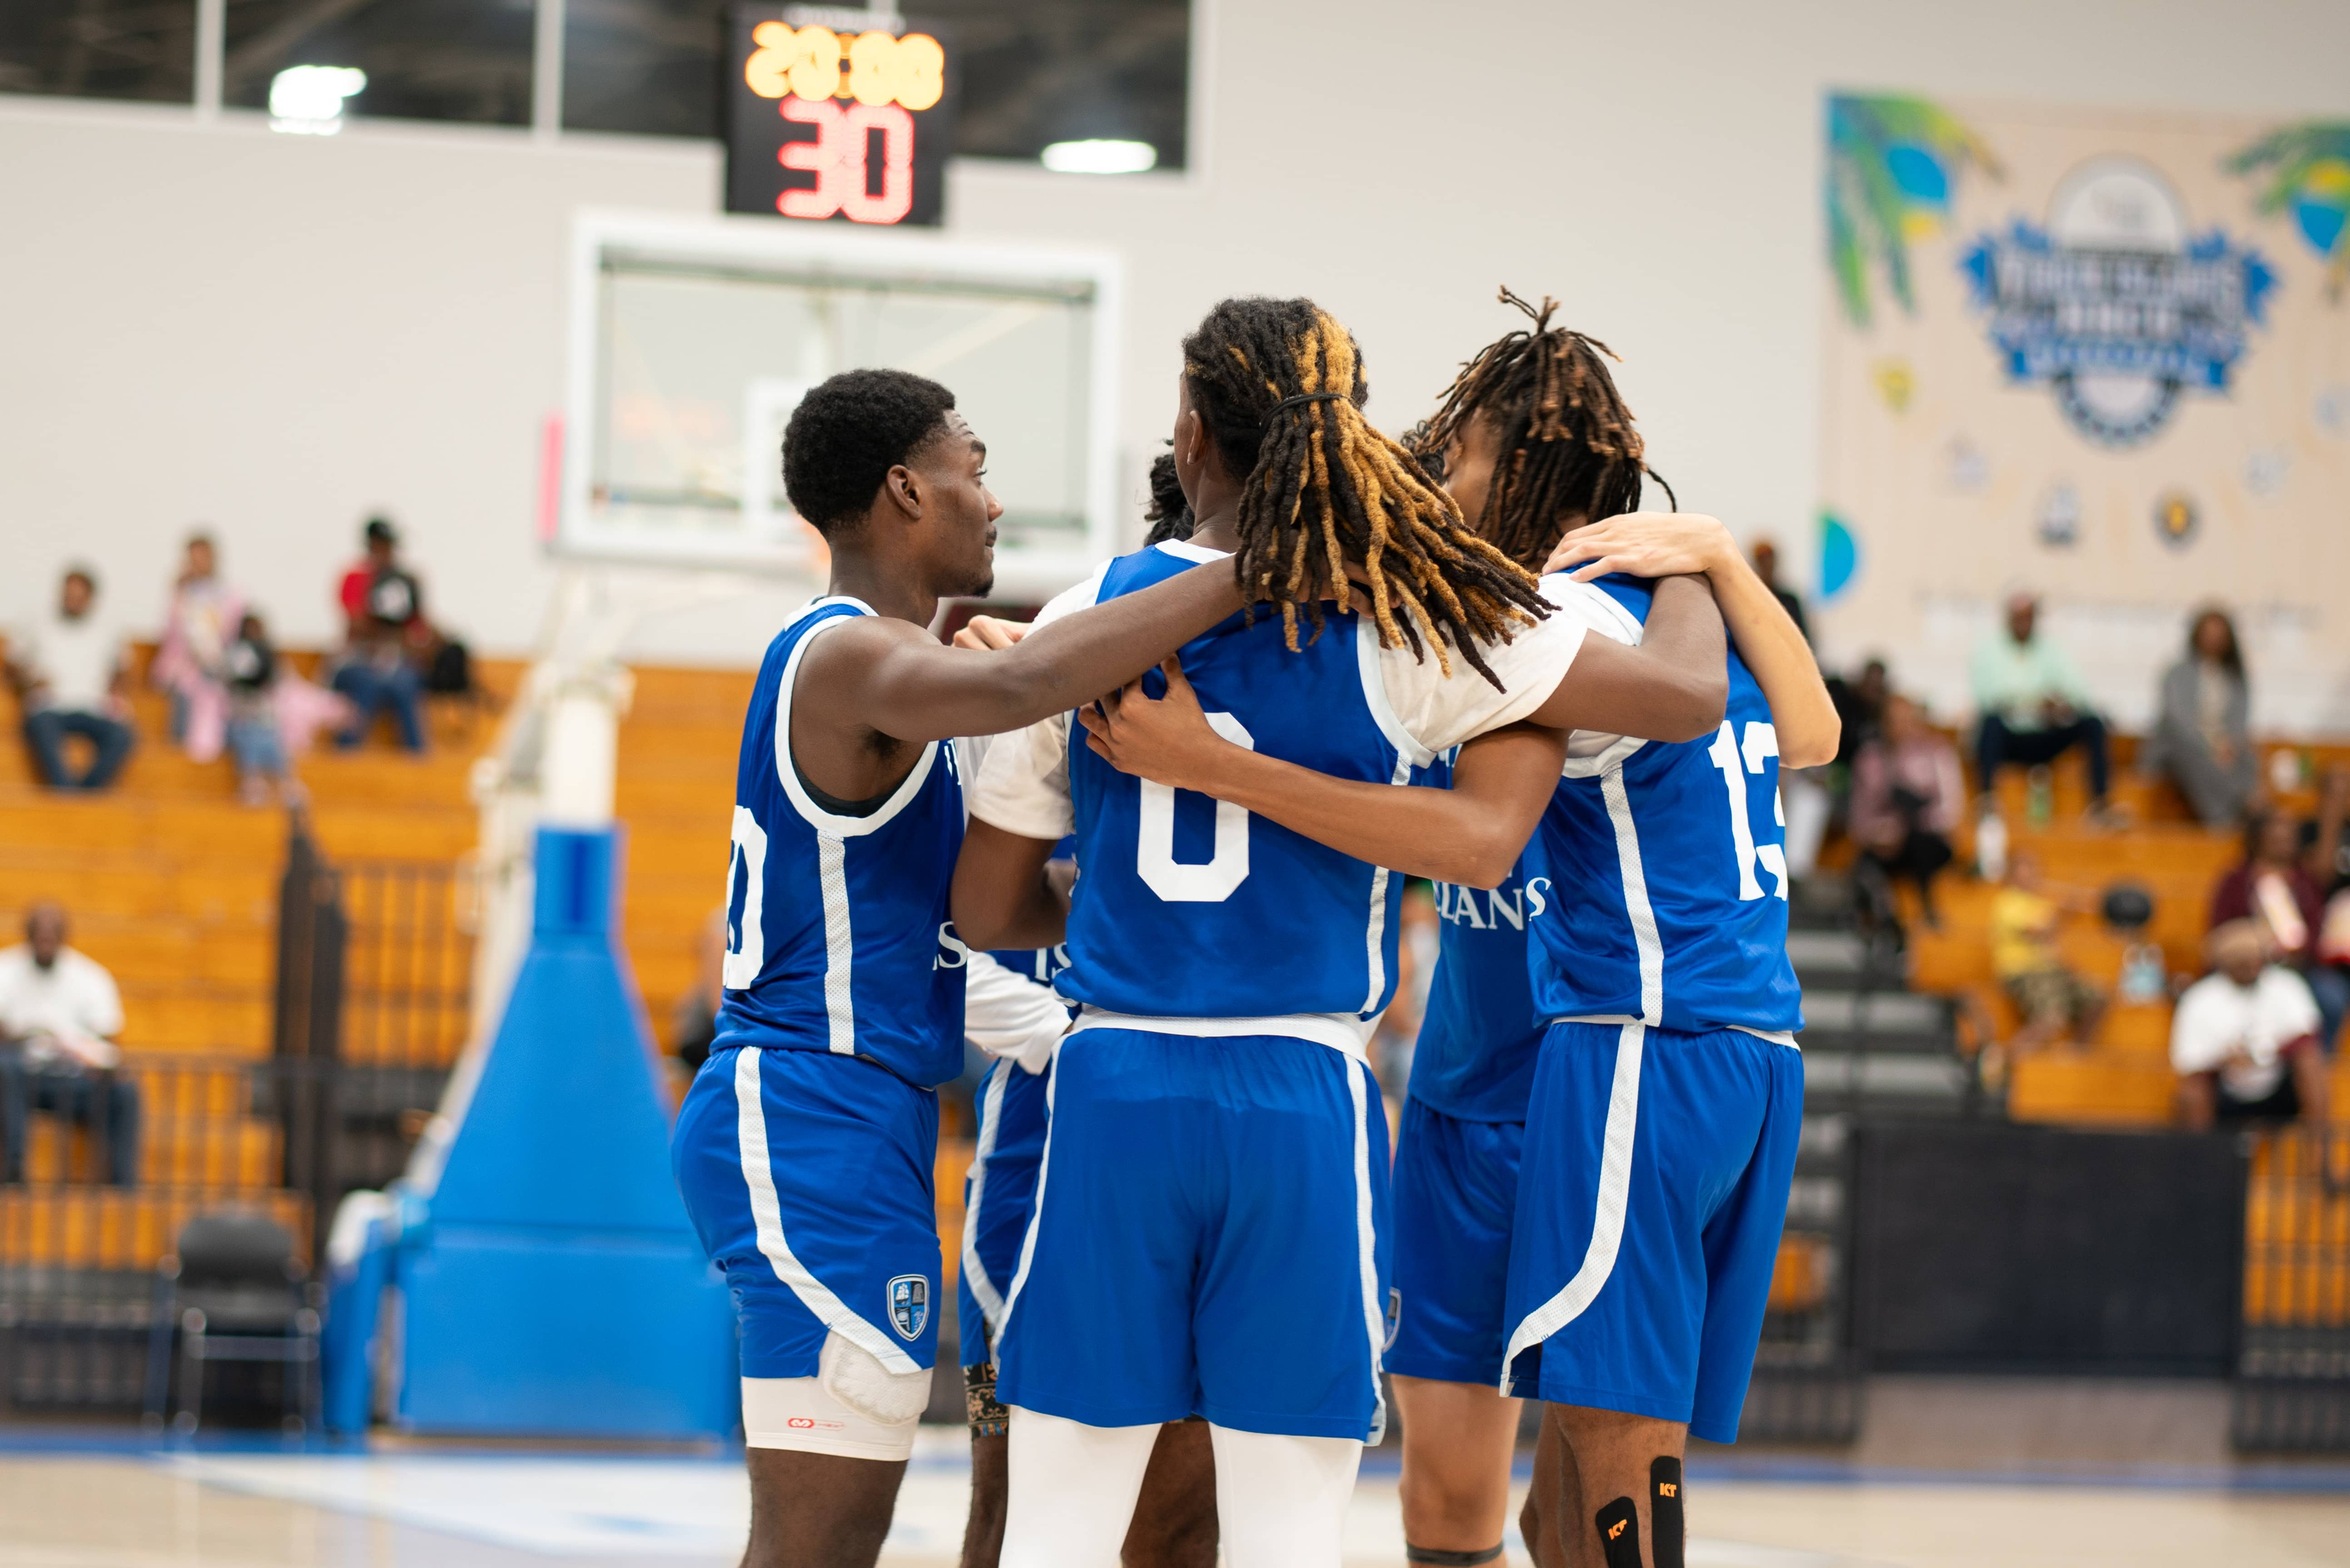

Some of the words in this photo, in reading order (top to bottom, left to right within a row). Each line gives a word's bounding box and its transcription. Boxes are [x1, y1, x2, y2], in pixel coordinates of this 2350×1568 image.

[776, 95, 914, 225] 30
[1137, 712, 1255, 902] 0
[1659, 1482, 1677, 1498] KT
[1608, 1518, 1628, 1540] KT
